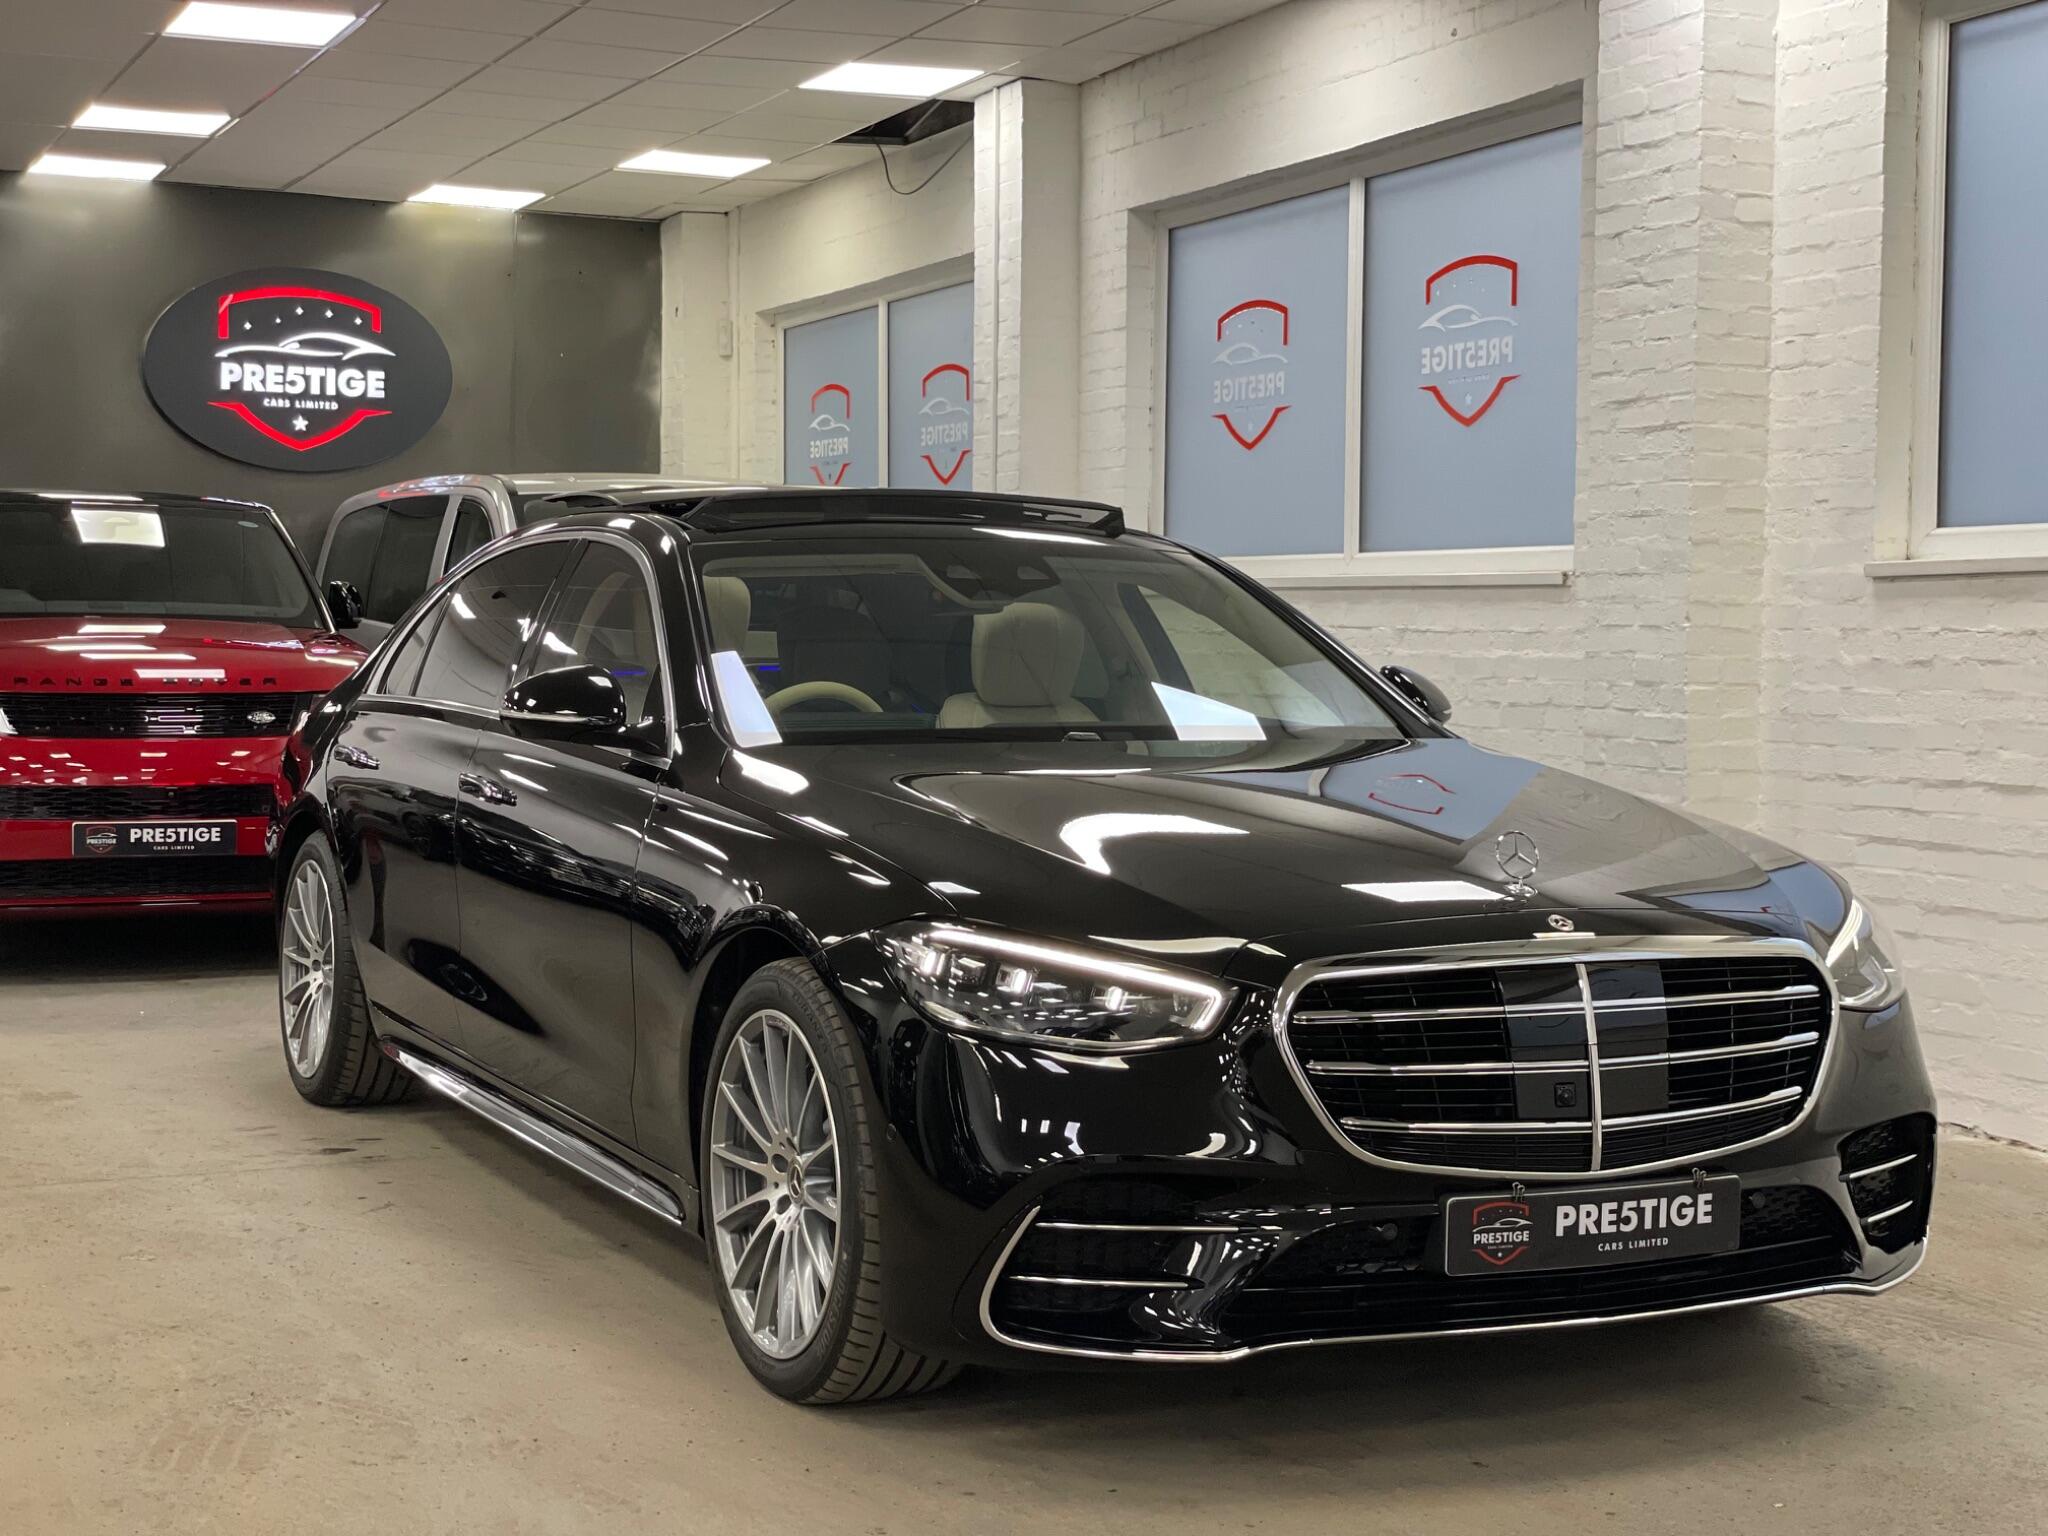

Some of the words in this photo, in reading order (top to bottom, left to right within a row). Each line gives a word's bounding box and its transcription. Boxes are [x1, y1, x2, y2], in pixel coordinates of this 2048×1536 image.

[263, 398, 291, 408] CARS
[295, 399, 339, 411] LIMITED
[13, 676, 134, 687] RANGE
[1598, 1241, 1623, 1252] CARS
[1628, 1237, 1669, 1249] LIMITED
